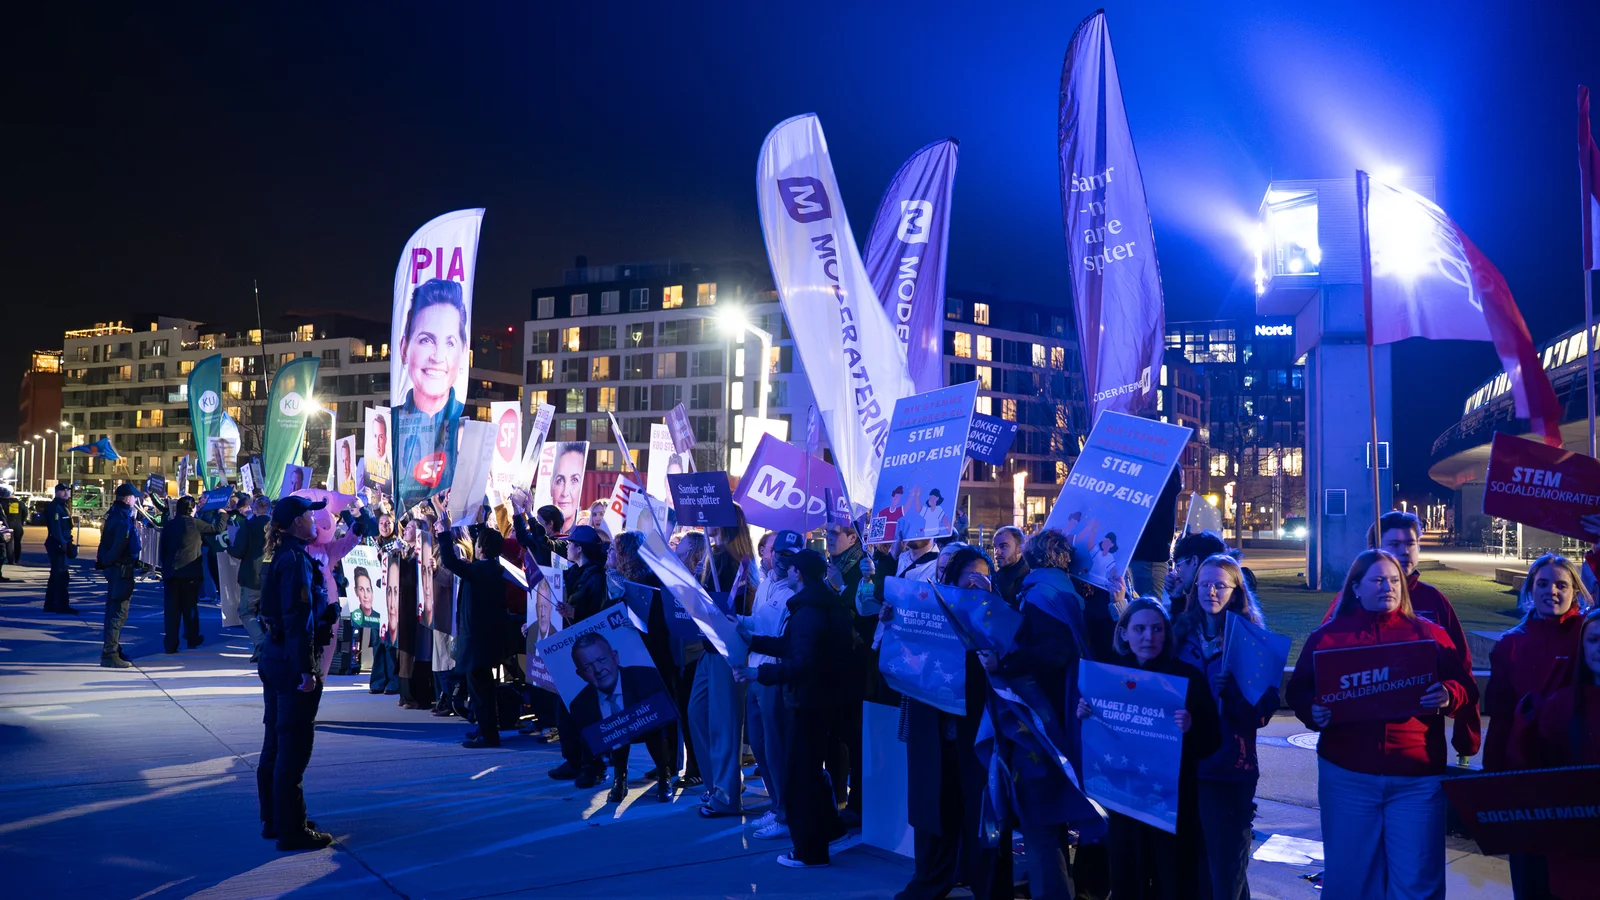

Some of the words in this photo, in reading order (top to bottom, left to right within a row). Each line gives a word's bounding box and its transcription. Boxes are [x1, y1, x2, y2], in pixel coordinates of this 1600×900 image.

[412, 247, 465, 284] PIA
[896, 256, 919, 353] MODE
[202, 395, 216, 408] KU
[284, 399, 300, 410] KU
[500, 422, 515, 448] SF
[908, 425, 945, 443] STEM
[970, 418, 1002, 435] LØKKE!
[664, 442, 674, 452] STE
[966, 440, 993, 456] ØKKE!
[968, 431, 997, 445] ØKKE!
[540, 446, 556, 475] PIA
[883, 444, 962, 469] EUROPÆISK
[1101, 456, 1143, 477] STEM
[421, 460, 443, 479] SF
[1512, 466, 1562, 488] STEM
[678, 484, 699, 495] Samler
[703, 482, 716, 493] når
[1069, 473, 1154, 508] EUROPÆISK
[1490, 481, 1600, 507] SOCIALDEMOKRATIET
[611, 484, 637, 519] PIA
[679, 495, 696, 506] andre
[697, 495, 720, 508] splitter
[920, 612, 931, 620] ER
[932, 613, 950, 623] OGS
[543, 619, 607, 656] MODERATERNE
[1321, 672, 1433, 704] SOCIALDEMOKRATIET
[1339, 666, 1390, 689] STEM
[600, 715, 630, 733] Samler
[635, 703, 651, 719] når
[1091, 697, 1124, 712] VALGET
[1126, 703, 1139, 714] ER
[1141, 706, 1165, 719] OGSÅ
[1102, 709, 1154, 726] EUROPÆISK
[602, 727, 628, 744] andre
[629, 712, 659, 734] splitter
[1476, 805, 1600, 824] SOCIALDEMOK
